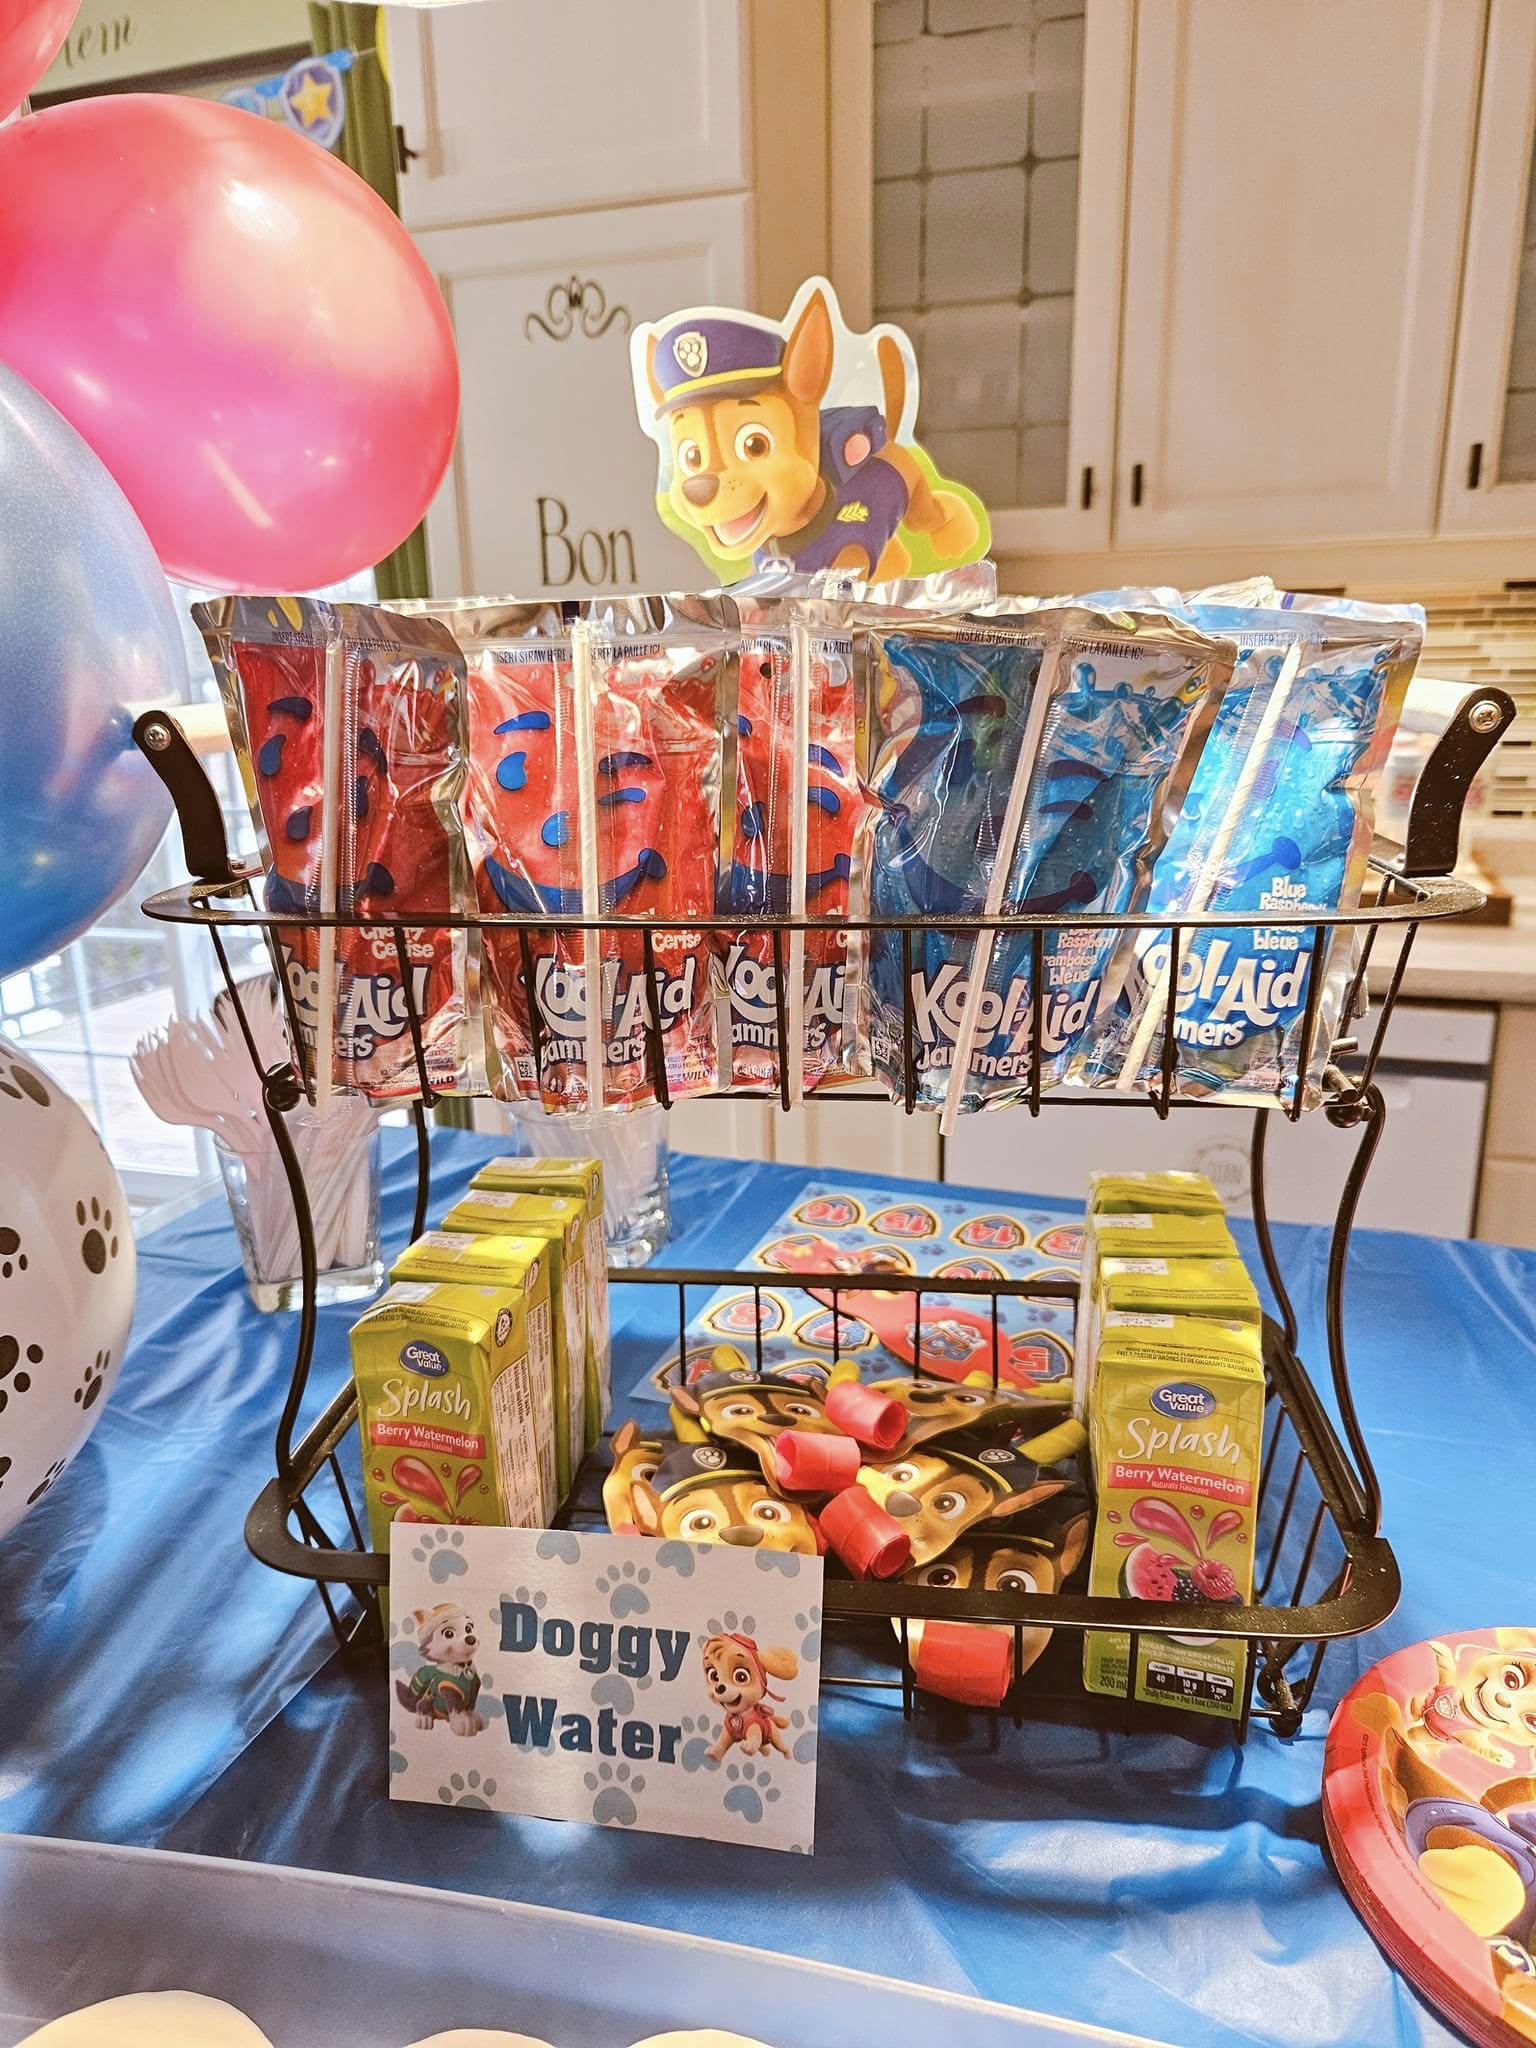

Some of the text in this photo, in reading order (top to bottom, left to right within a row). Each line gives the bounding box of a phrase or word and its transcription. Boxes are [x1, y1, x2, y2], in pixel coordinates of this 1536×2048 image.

[537, 497, 638, 586] Bon
[956, 629, 984, 643] INSERT
[986, 630, 1015, 645] STRAW
[520, 649, 546, 663] STRAW
[624, 645, 647, 658] PAILLE
[1101, 642, 1129, 659] PAILLE
[1272, 876, 1306, 899] Blue
[371, 940, 435, 960] Ceise
[651, 930, 701, 953] Cerise
[1253, 931, 1298, 951] bleue
[1043, 951, 1098, 967] ramboise
[1049, 966, 1090, 986] bleue
[406, 1346, 442, 1363] Great
[416, 1358, 443, 1372] Value
[376, 1378, 472, 1421] Splash
[1158, 1388, 1206, 1406] Great
[1169, 1401, 1206, 1414] Value
[377, 1423, 479, 1450] Berry Watermelon
[1117, 1417, 1242, 1465] Splash
[1115, 1465, 1246, 1495] Berry Watermelon
[1151, 1480, 1210, 1496] Naturally Flavoured
[499, 1601, 691, 1682] Doggy
[502, 1693, 682, 1764] Water
